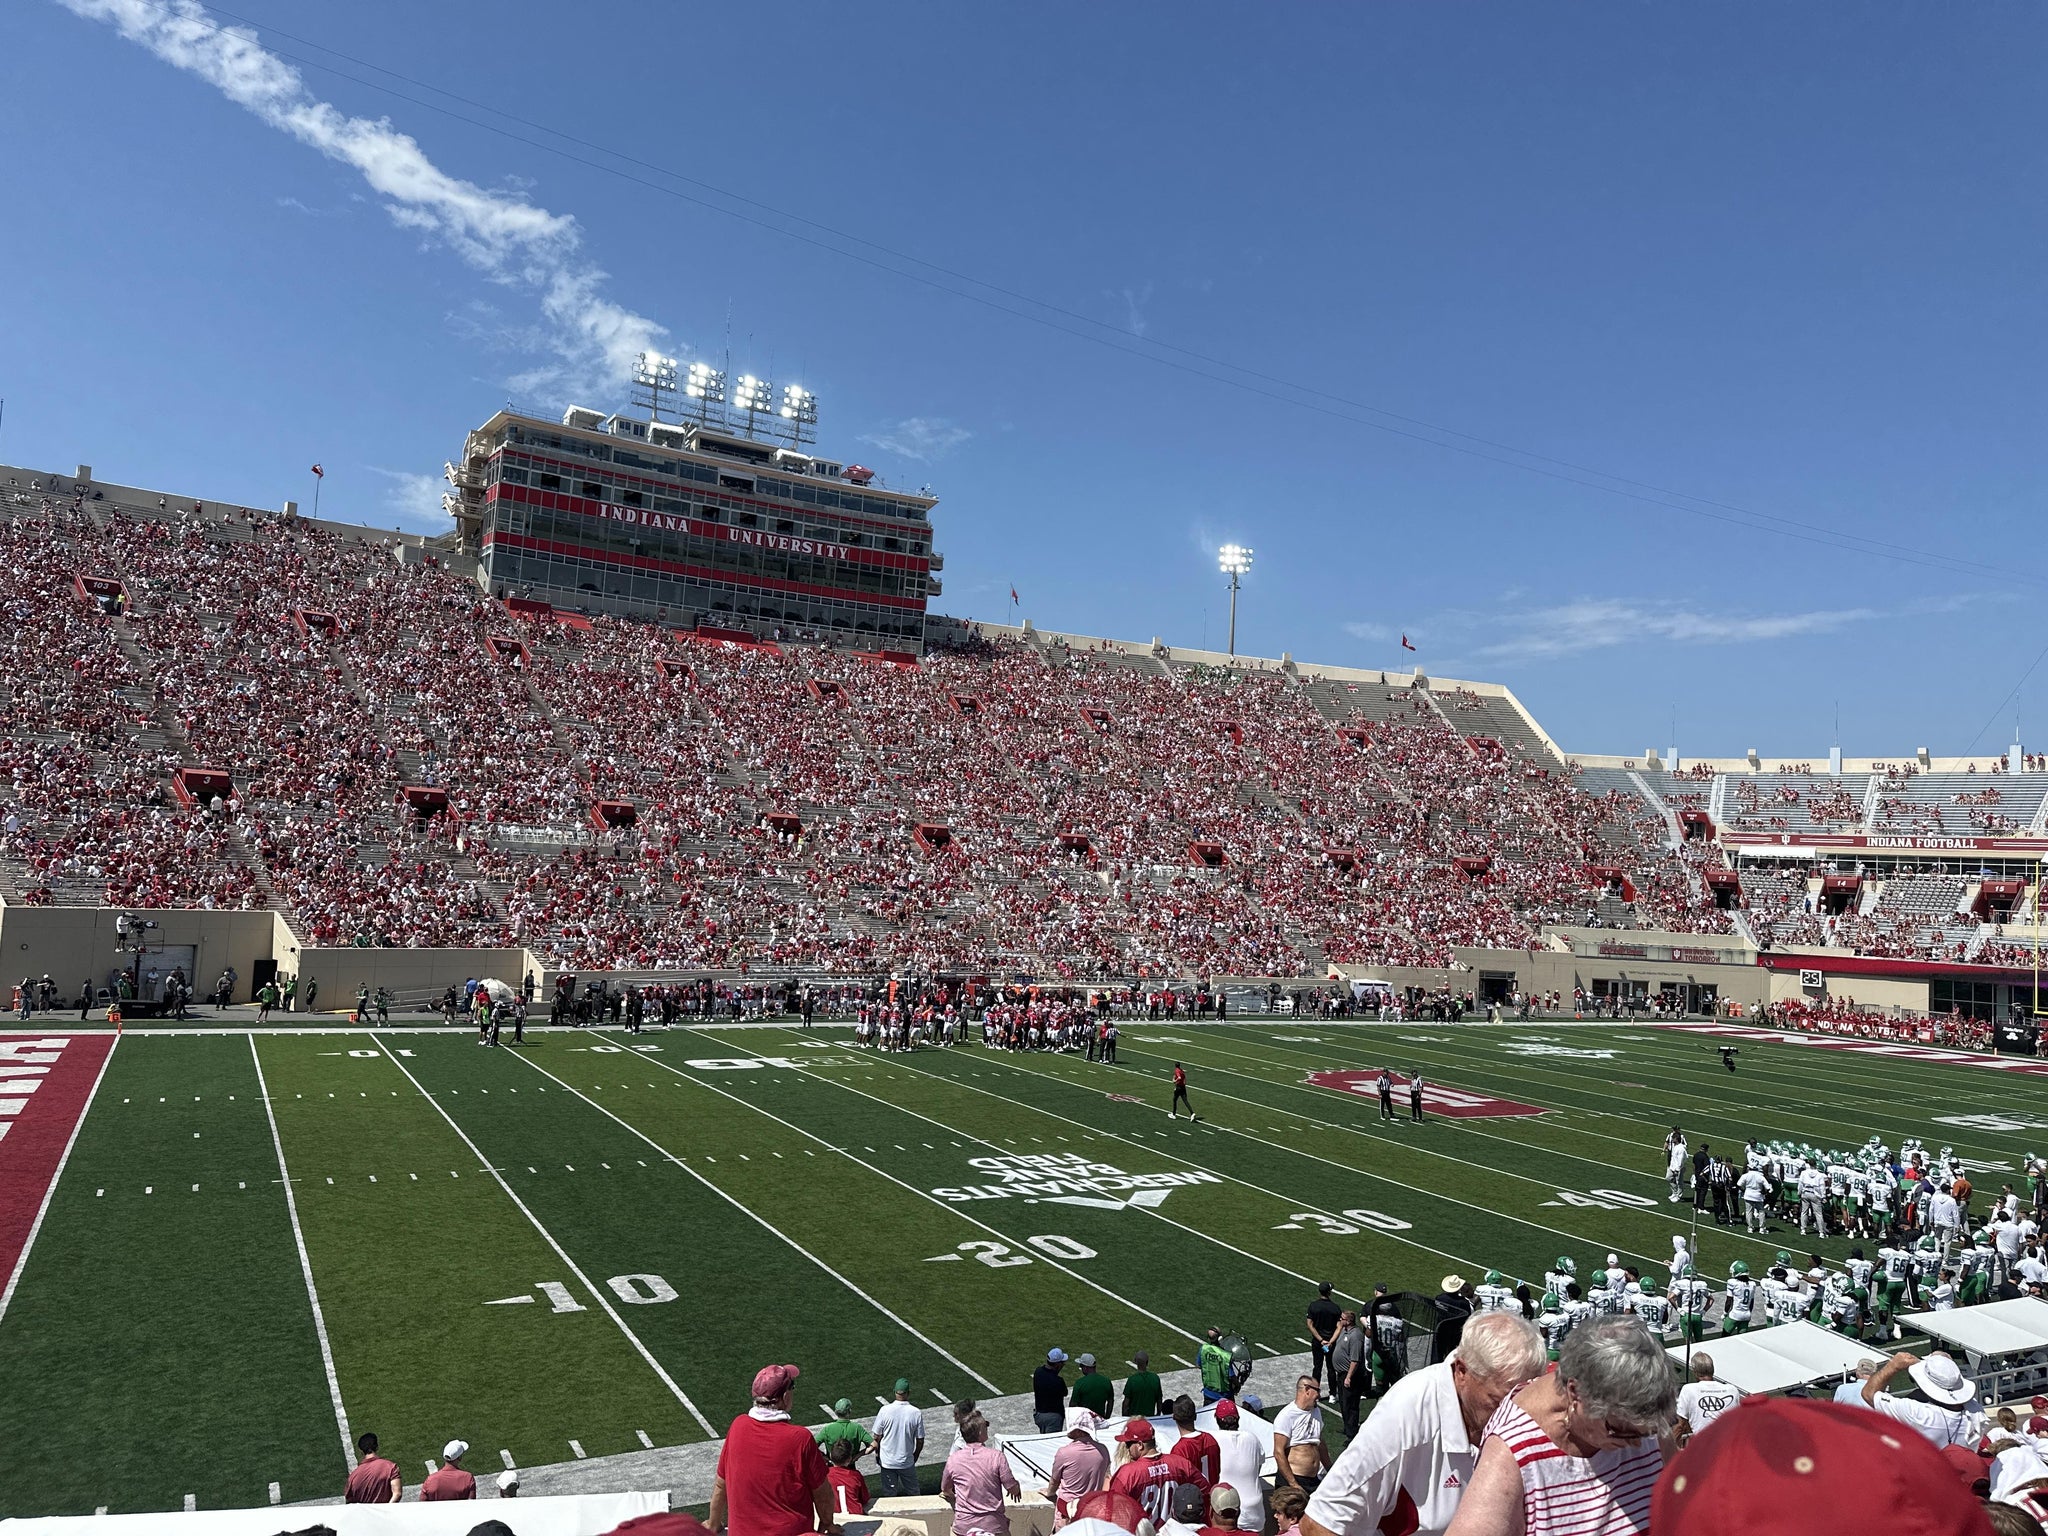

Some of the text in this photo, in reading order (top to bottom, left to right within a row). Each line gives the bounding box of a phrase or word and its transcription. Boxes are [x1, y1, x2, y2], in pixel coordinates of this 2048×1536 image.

[599, 504, 848, 559] INDIANA UNIVERSITY
[93, 581, 109, 590] 103
[311, 614, 325, 622] 104
[203, 776, 211, 784] 3
[423, 793, 430, 801] 4
[615, 806, 621, 814] 5
[1866, 837, 1978, 849] INDIANA FOOTBALL
[1684, 955, 1722, 963] TOMORROW
[1803, 972, 1819, 984] 25
[112, 1013, 120, 1021] G
[348, 1048, 417, 1058] 10
[968, 1152, 1093, 1169] FIELD
[979, 1163, 1128, 1183] BANK
[931, 1171, 1223, 1201] MERCHANTS
[1853, 1178, 1867, 1190] 89
[1556, 1188, 1659, 1210] 40
[1875, 1189, 1881, 1202] 0
[1290, 1208, 1413, 1235] 30
[956, 1234, 1099, 1268] 20
[1892, 1257, 1906, 1273] 66
[1861, 1269, 1869, 1284] 6
[534, 1273, 680, 1313] 10
[1742, 1289, 1750, 1305] 8
[1640, 1304, 1658, 1323] 98
[1781, 1300, 1797, 1318] 34
[1701, 1396, 1723, 1411] AAA
[837, 1485, 850, 1515] 1
